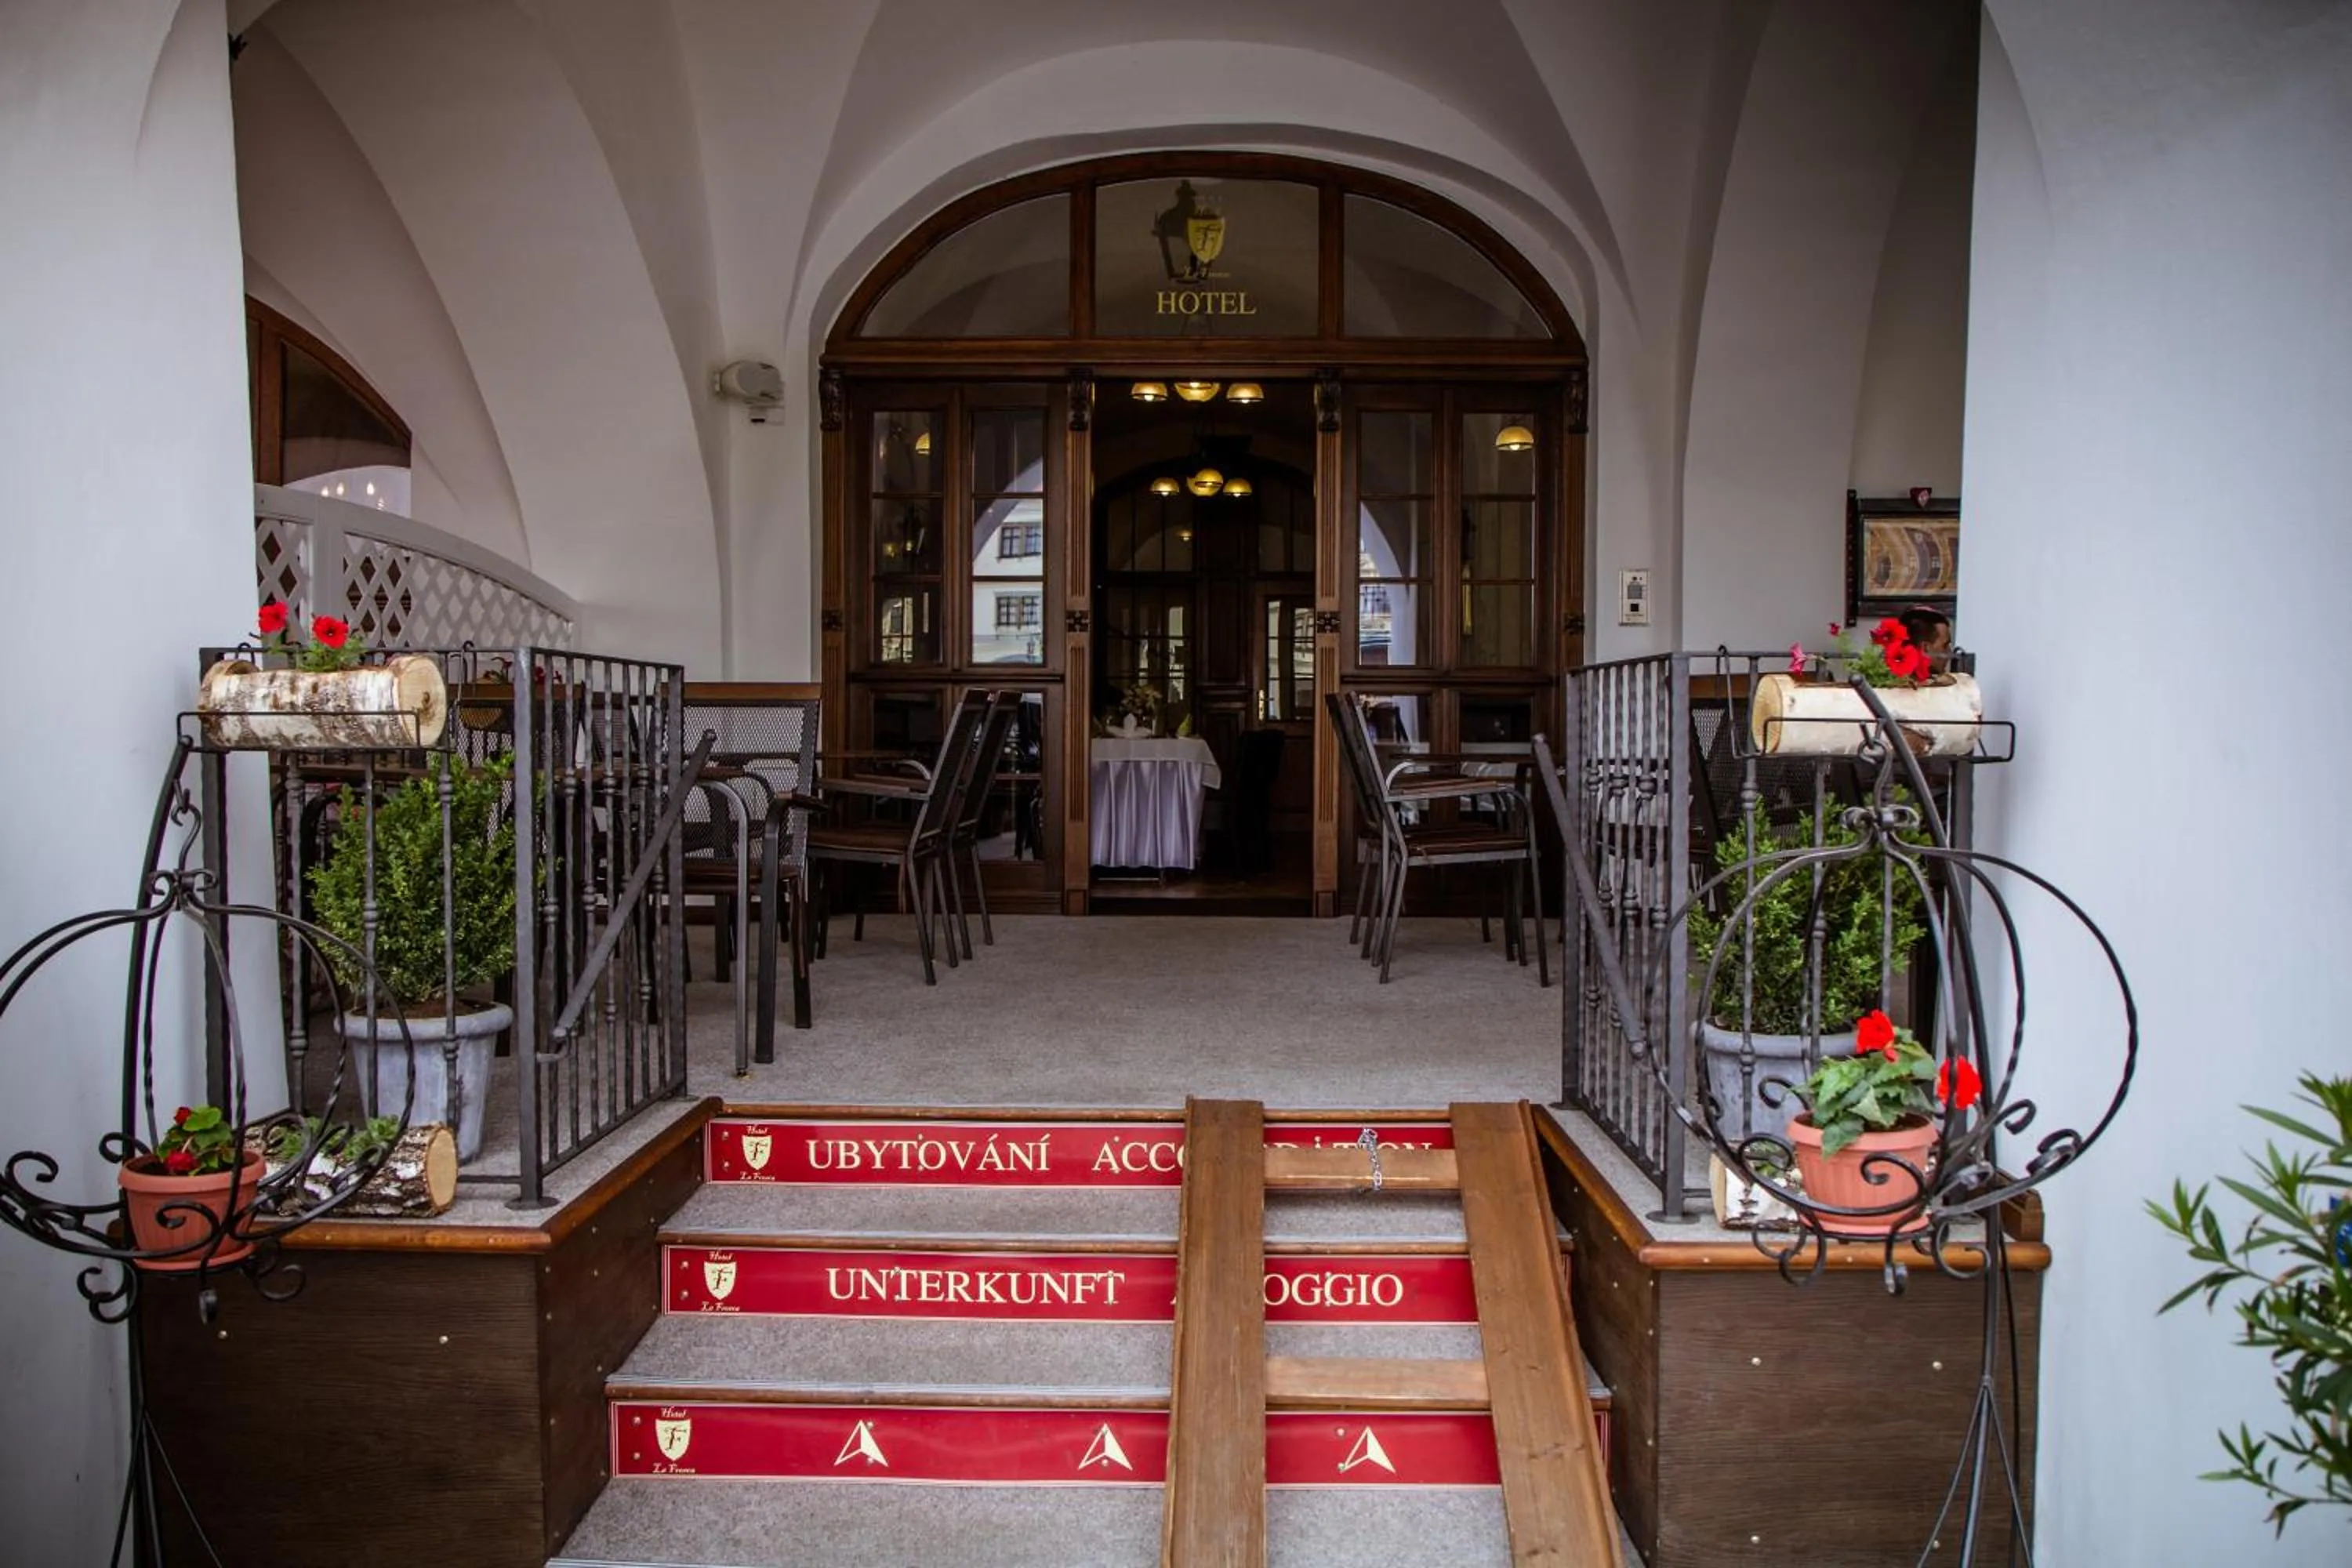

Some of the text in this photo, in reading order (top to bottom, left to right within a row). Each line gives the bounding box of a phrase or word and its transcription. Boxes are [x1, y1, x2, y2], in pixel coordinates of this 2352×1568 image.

[1156, 291, 1256, 314] HOTEL
[806, 1134, 1051, 1171] UBYTOVÁNÍ
[826, 1267, 1403, 1306] UNTERKUNFT OGGIO
